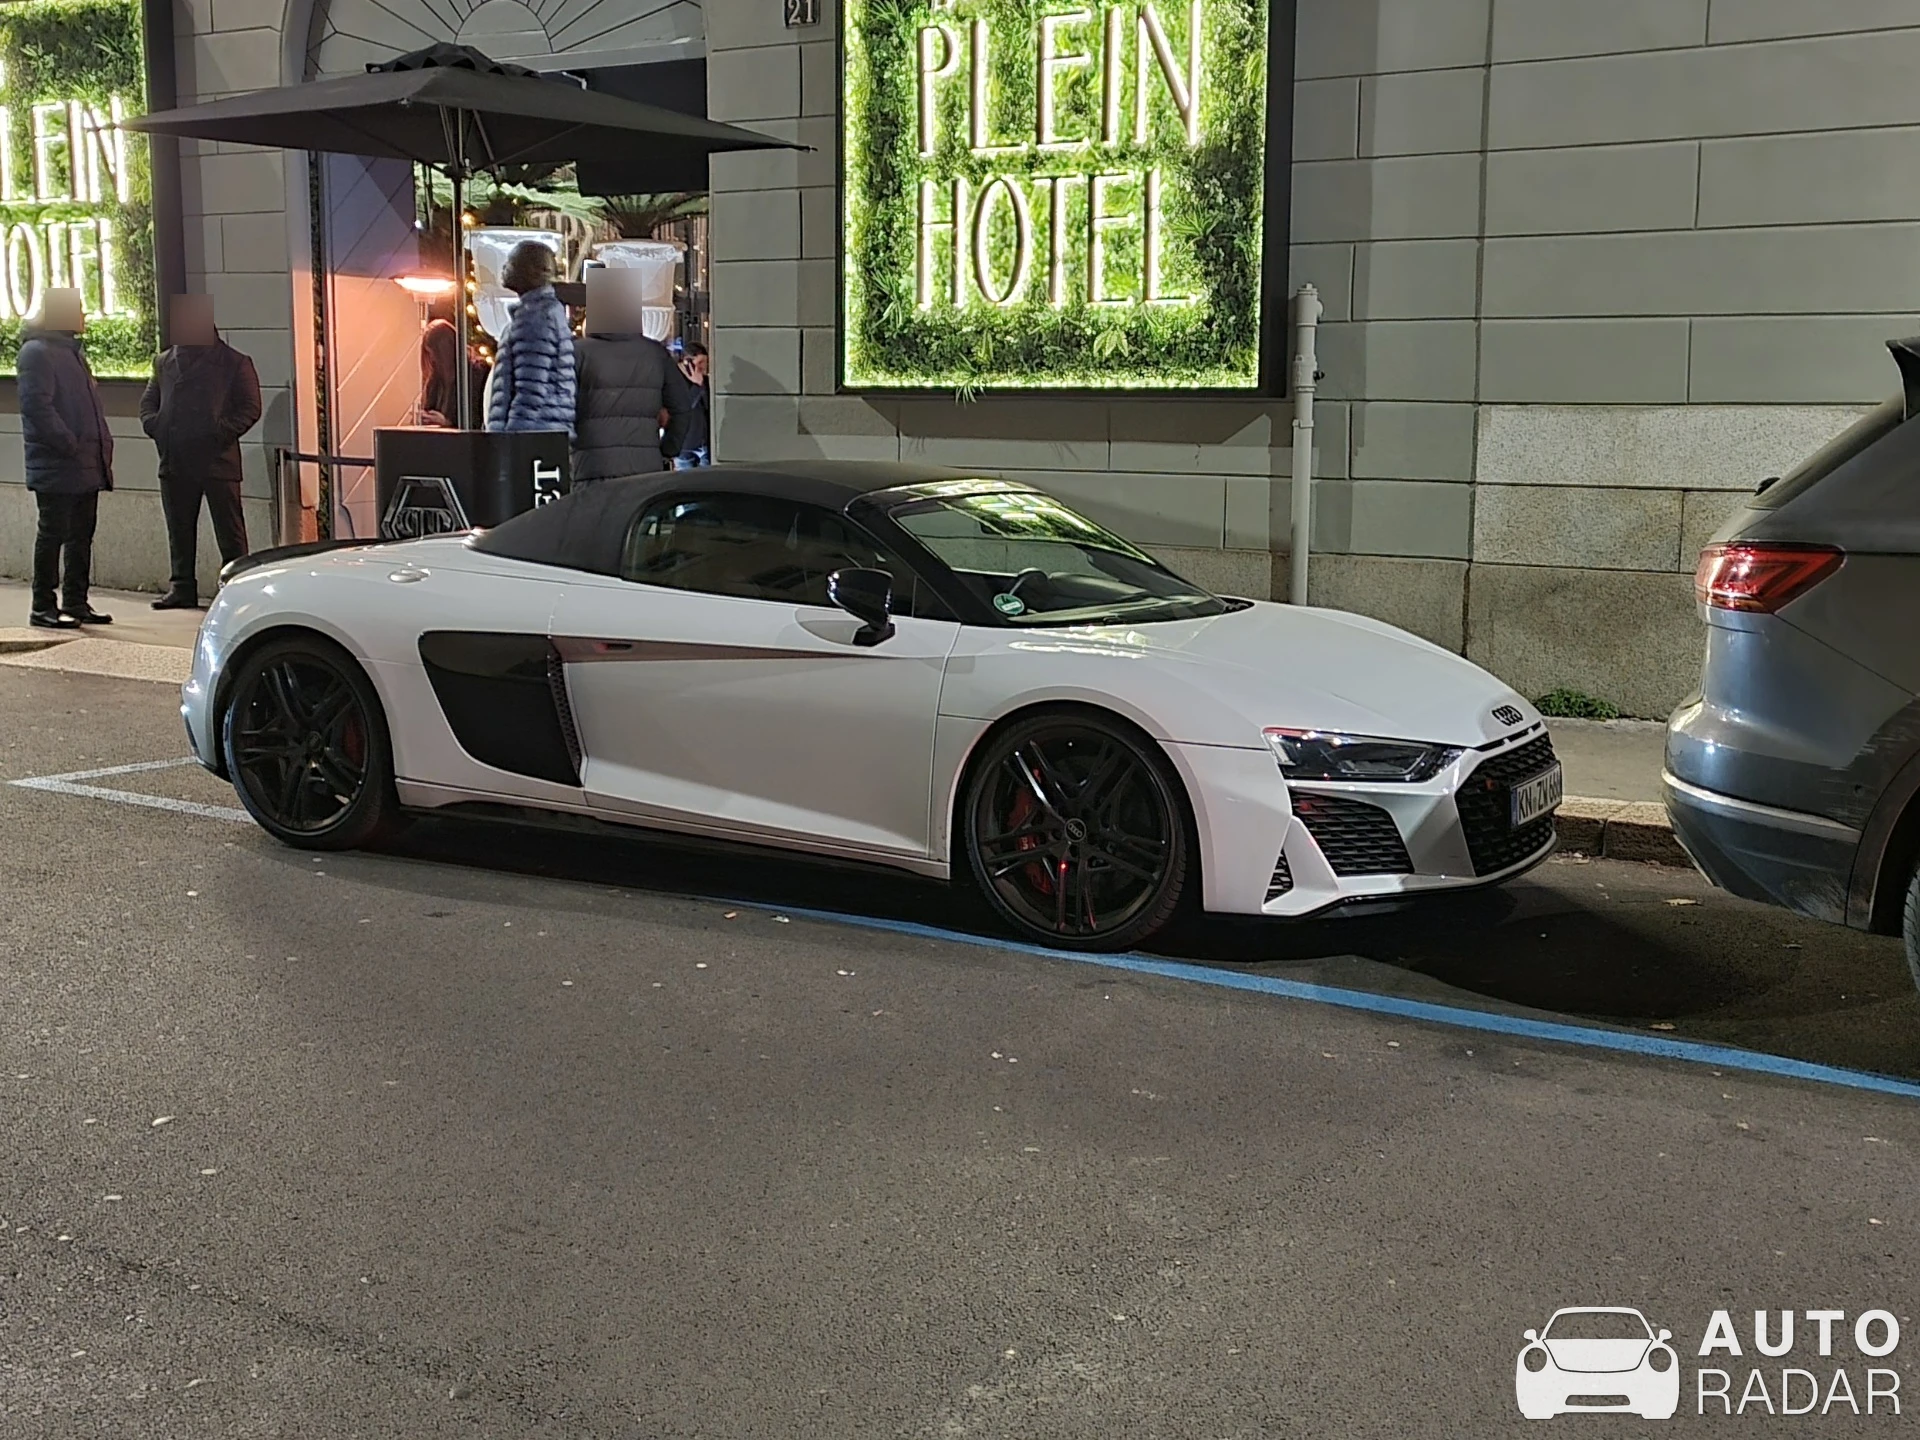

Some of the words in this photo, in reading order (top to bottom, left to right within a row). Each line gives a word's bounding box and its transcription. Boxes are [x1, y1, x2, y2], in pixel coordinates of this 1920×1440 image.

[788, 0, 814, 25] 21
[918, 0, 1202, 156] PLEIN
[917, 168, 1199, 310] HOTEL
